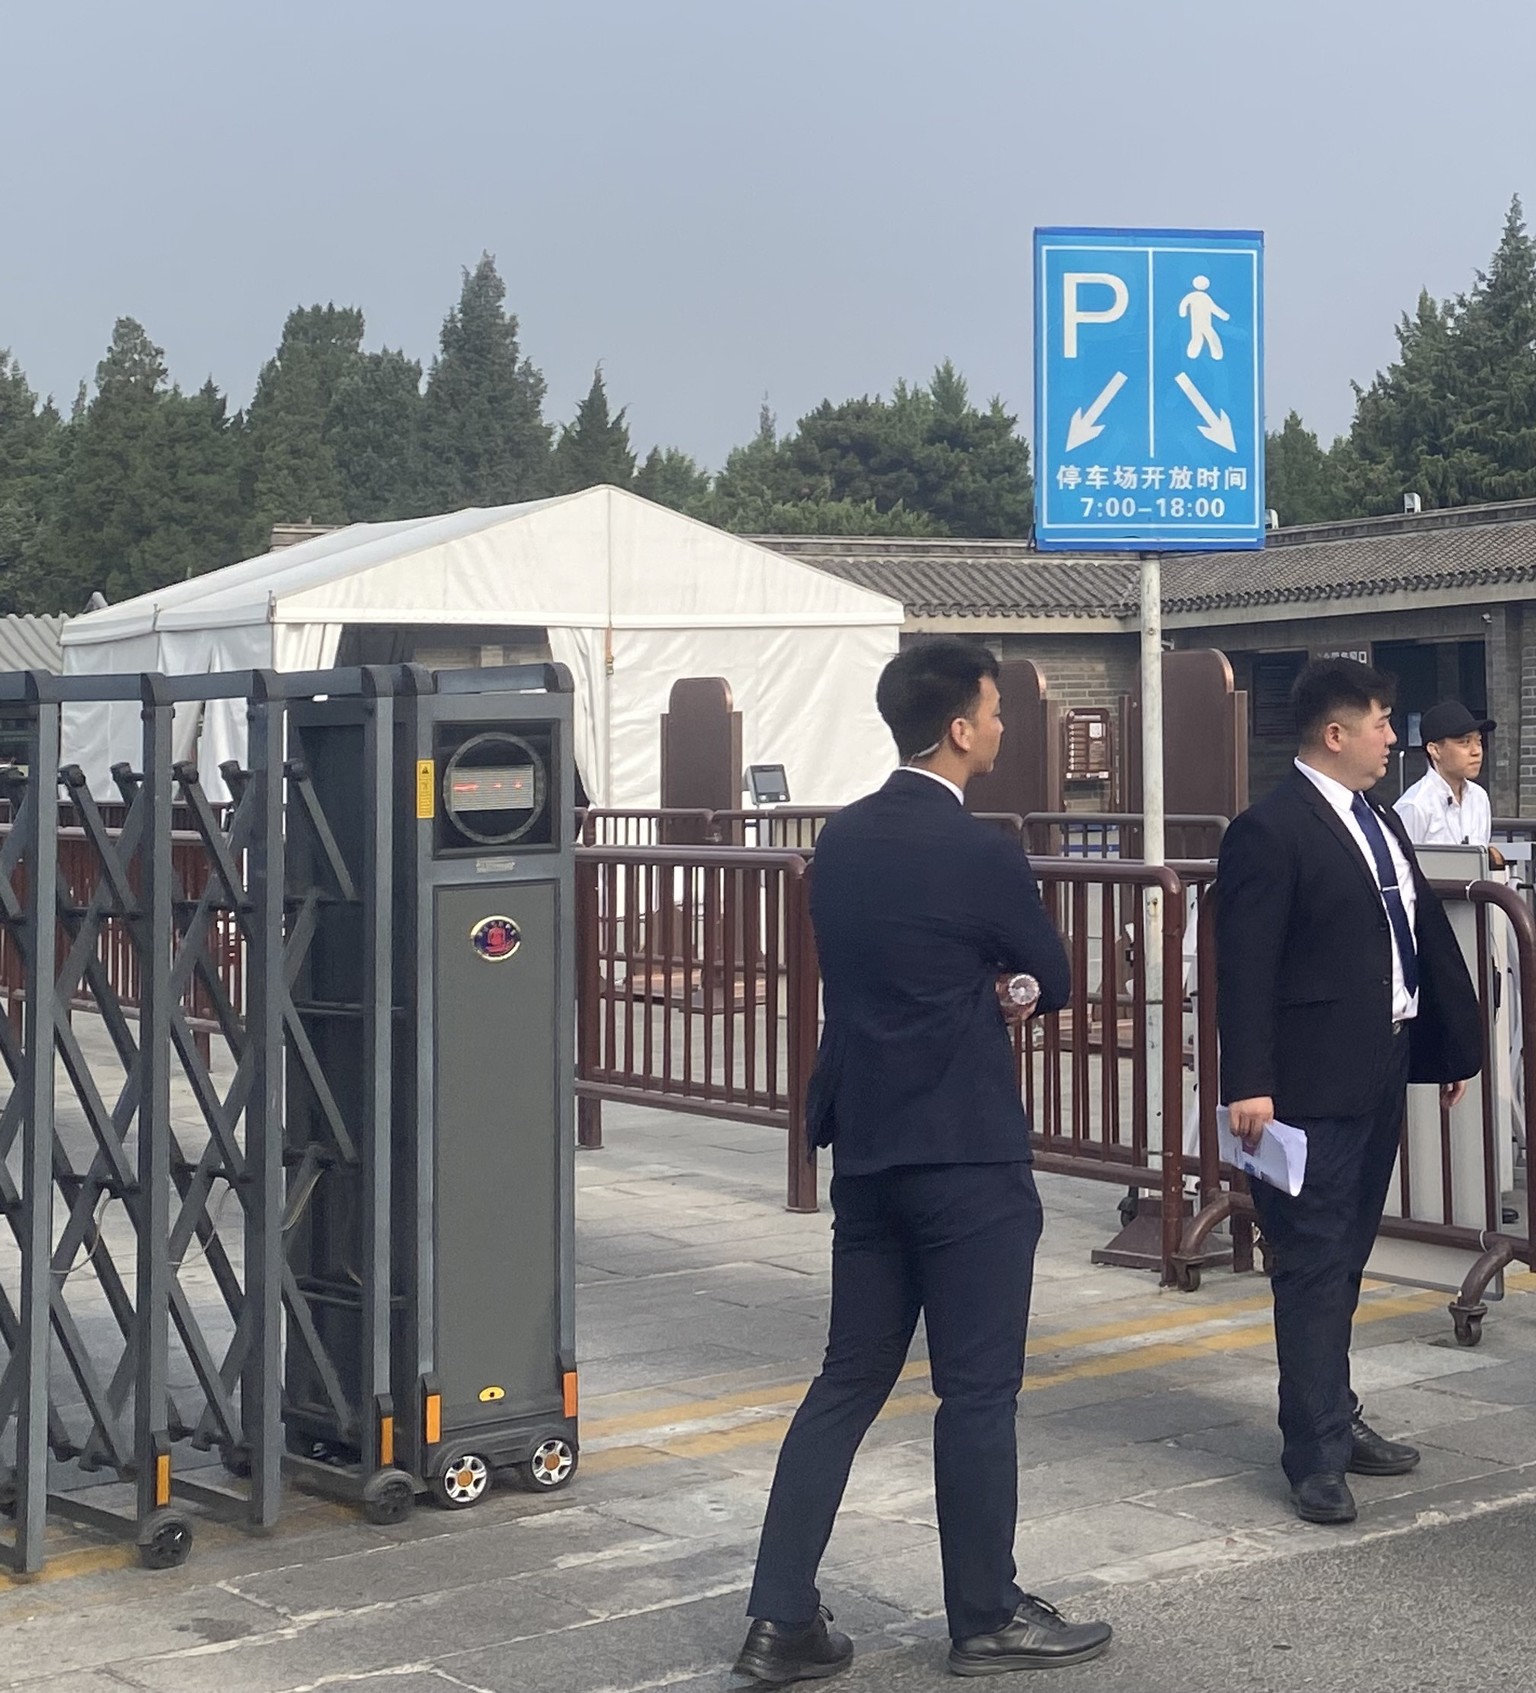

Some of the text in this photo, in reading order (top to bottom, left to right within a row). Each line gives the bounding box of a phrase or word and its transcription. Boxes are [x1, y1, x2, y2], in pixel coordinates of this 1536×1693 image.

[1063, 272, 1129, 358] P
[1056, 465, 1248, 491] 停车场开放时间
[1080, 497, 1225, 518] 7:00-18:00
